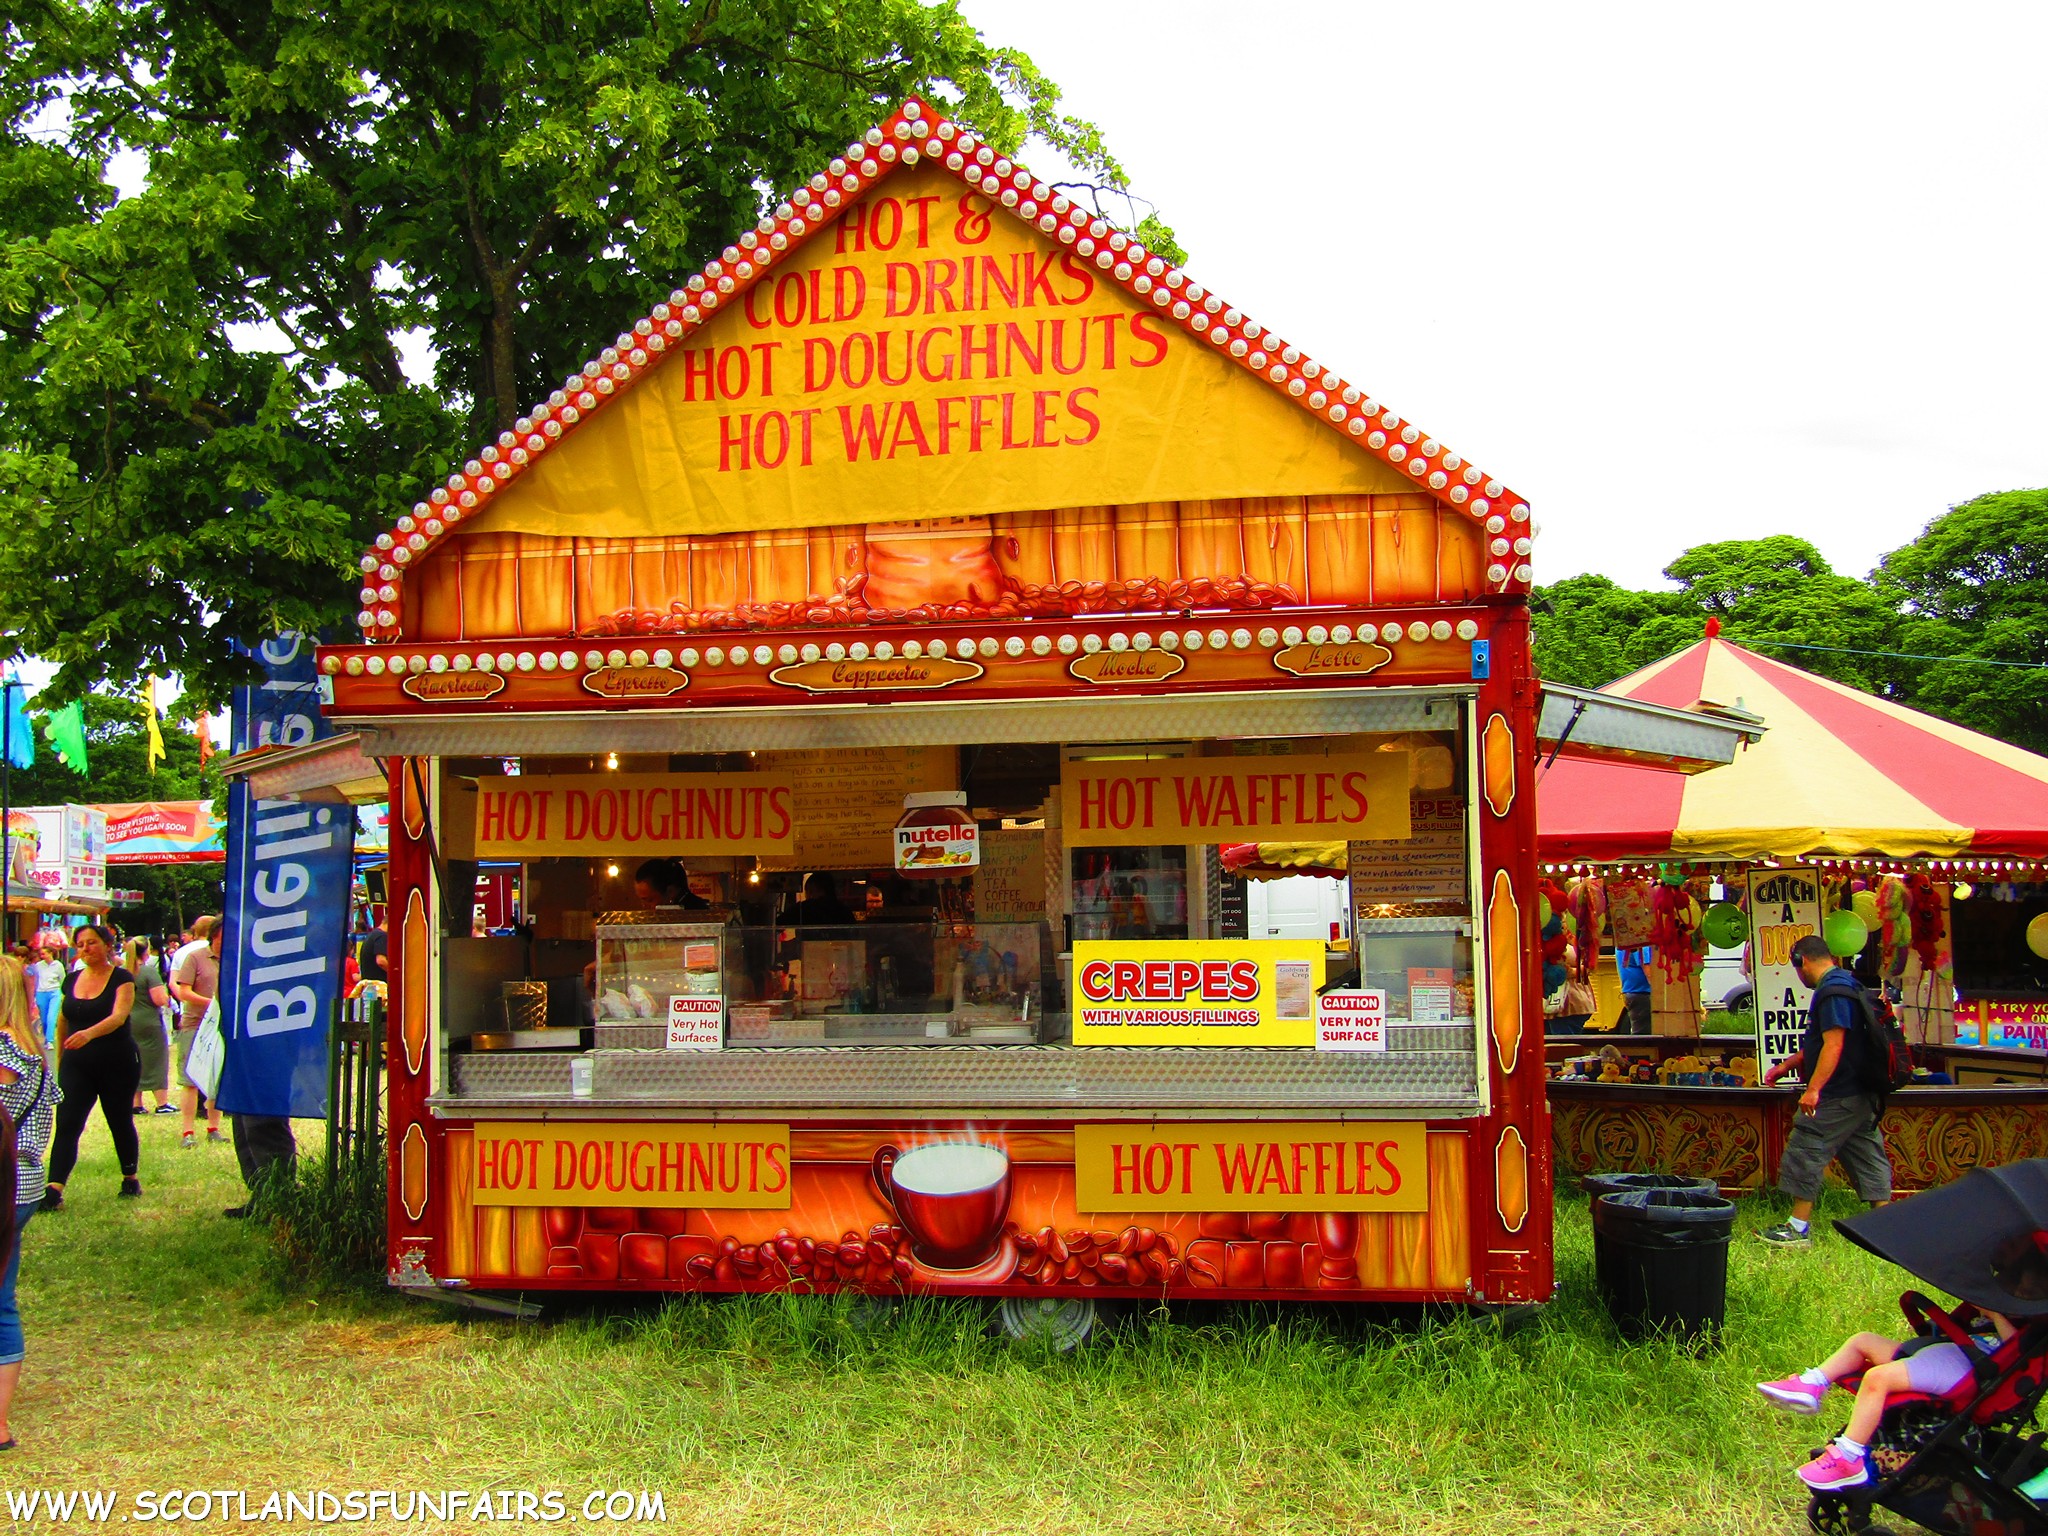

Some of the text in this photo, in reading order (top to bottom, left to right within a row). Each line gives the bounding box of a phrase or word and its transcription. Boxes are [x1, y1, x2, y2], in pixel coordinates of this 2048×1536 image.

[833, 191, 995, 255] HOT &
[744, 250, 1096, 330] COLD DRINKS
[682, 310, 1170, 403] HOT DOUGHNUTS
[718, 386, 1101, 473] HOT WAFFLES
[1097, 652, 1158, 677] Mocha
[1305, 642, 1365, 670] Latte
[415, 673, 495, 697] Americano
[604, 668, 670, 695] Espresso
[830, 660, 932, 690] Cappuccino
[1078, 771, 1370, 831] HOT WAFFLES
[117, 821, 131, 831] FOR
[131, 813, 160, 828] VISITING
[481, 786, 792, 842] HOT DOUGHNUTS
[115, 830, 128, 839] SEE
[128, 826, 143, 836] YOU
[143, 822, 164, 834] AGAIN
[165, 822, 187, 832] SOON
[899, 824, 975, 844] nutella
[984, 878, 1007, 889] TEA
[1754, 874, 1816, 904] CATCH
[984, 889, 1021, 901] COFFEE
[986, 901, 1009, 913] HOT
[1780, 903, 1795, 923] A
[1079, 960, 1260, 1002] CREPES
[674, 1001, 721, 1012] CAUTION
[1323, 997, 1378, 1009] CAUTION
[1783, 987, 1796, 1007] A
[1081, 1009, 1260, 1026] WITH VARIOUS FILLINGS
[2001, 1003, 2029, 1013] TRY
[672, 1018, 719, 1031] Very Hot
[1319, 1016, 1382, 1027] VERY HOT
[1763, 1010, 1810, 1031] PRIZ
[670, 1032, 719, 1044] Surfaces
[1322, 1031, 1380, 1042] SURFACE
[2003, 1025, 2048, 1039] PAIN
[477, 1137, 790, 1194] HOT DOUGHNUTS
[1110, 1140, 1403, 1196] HOT WAFFLES
